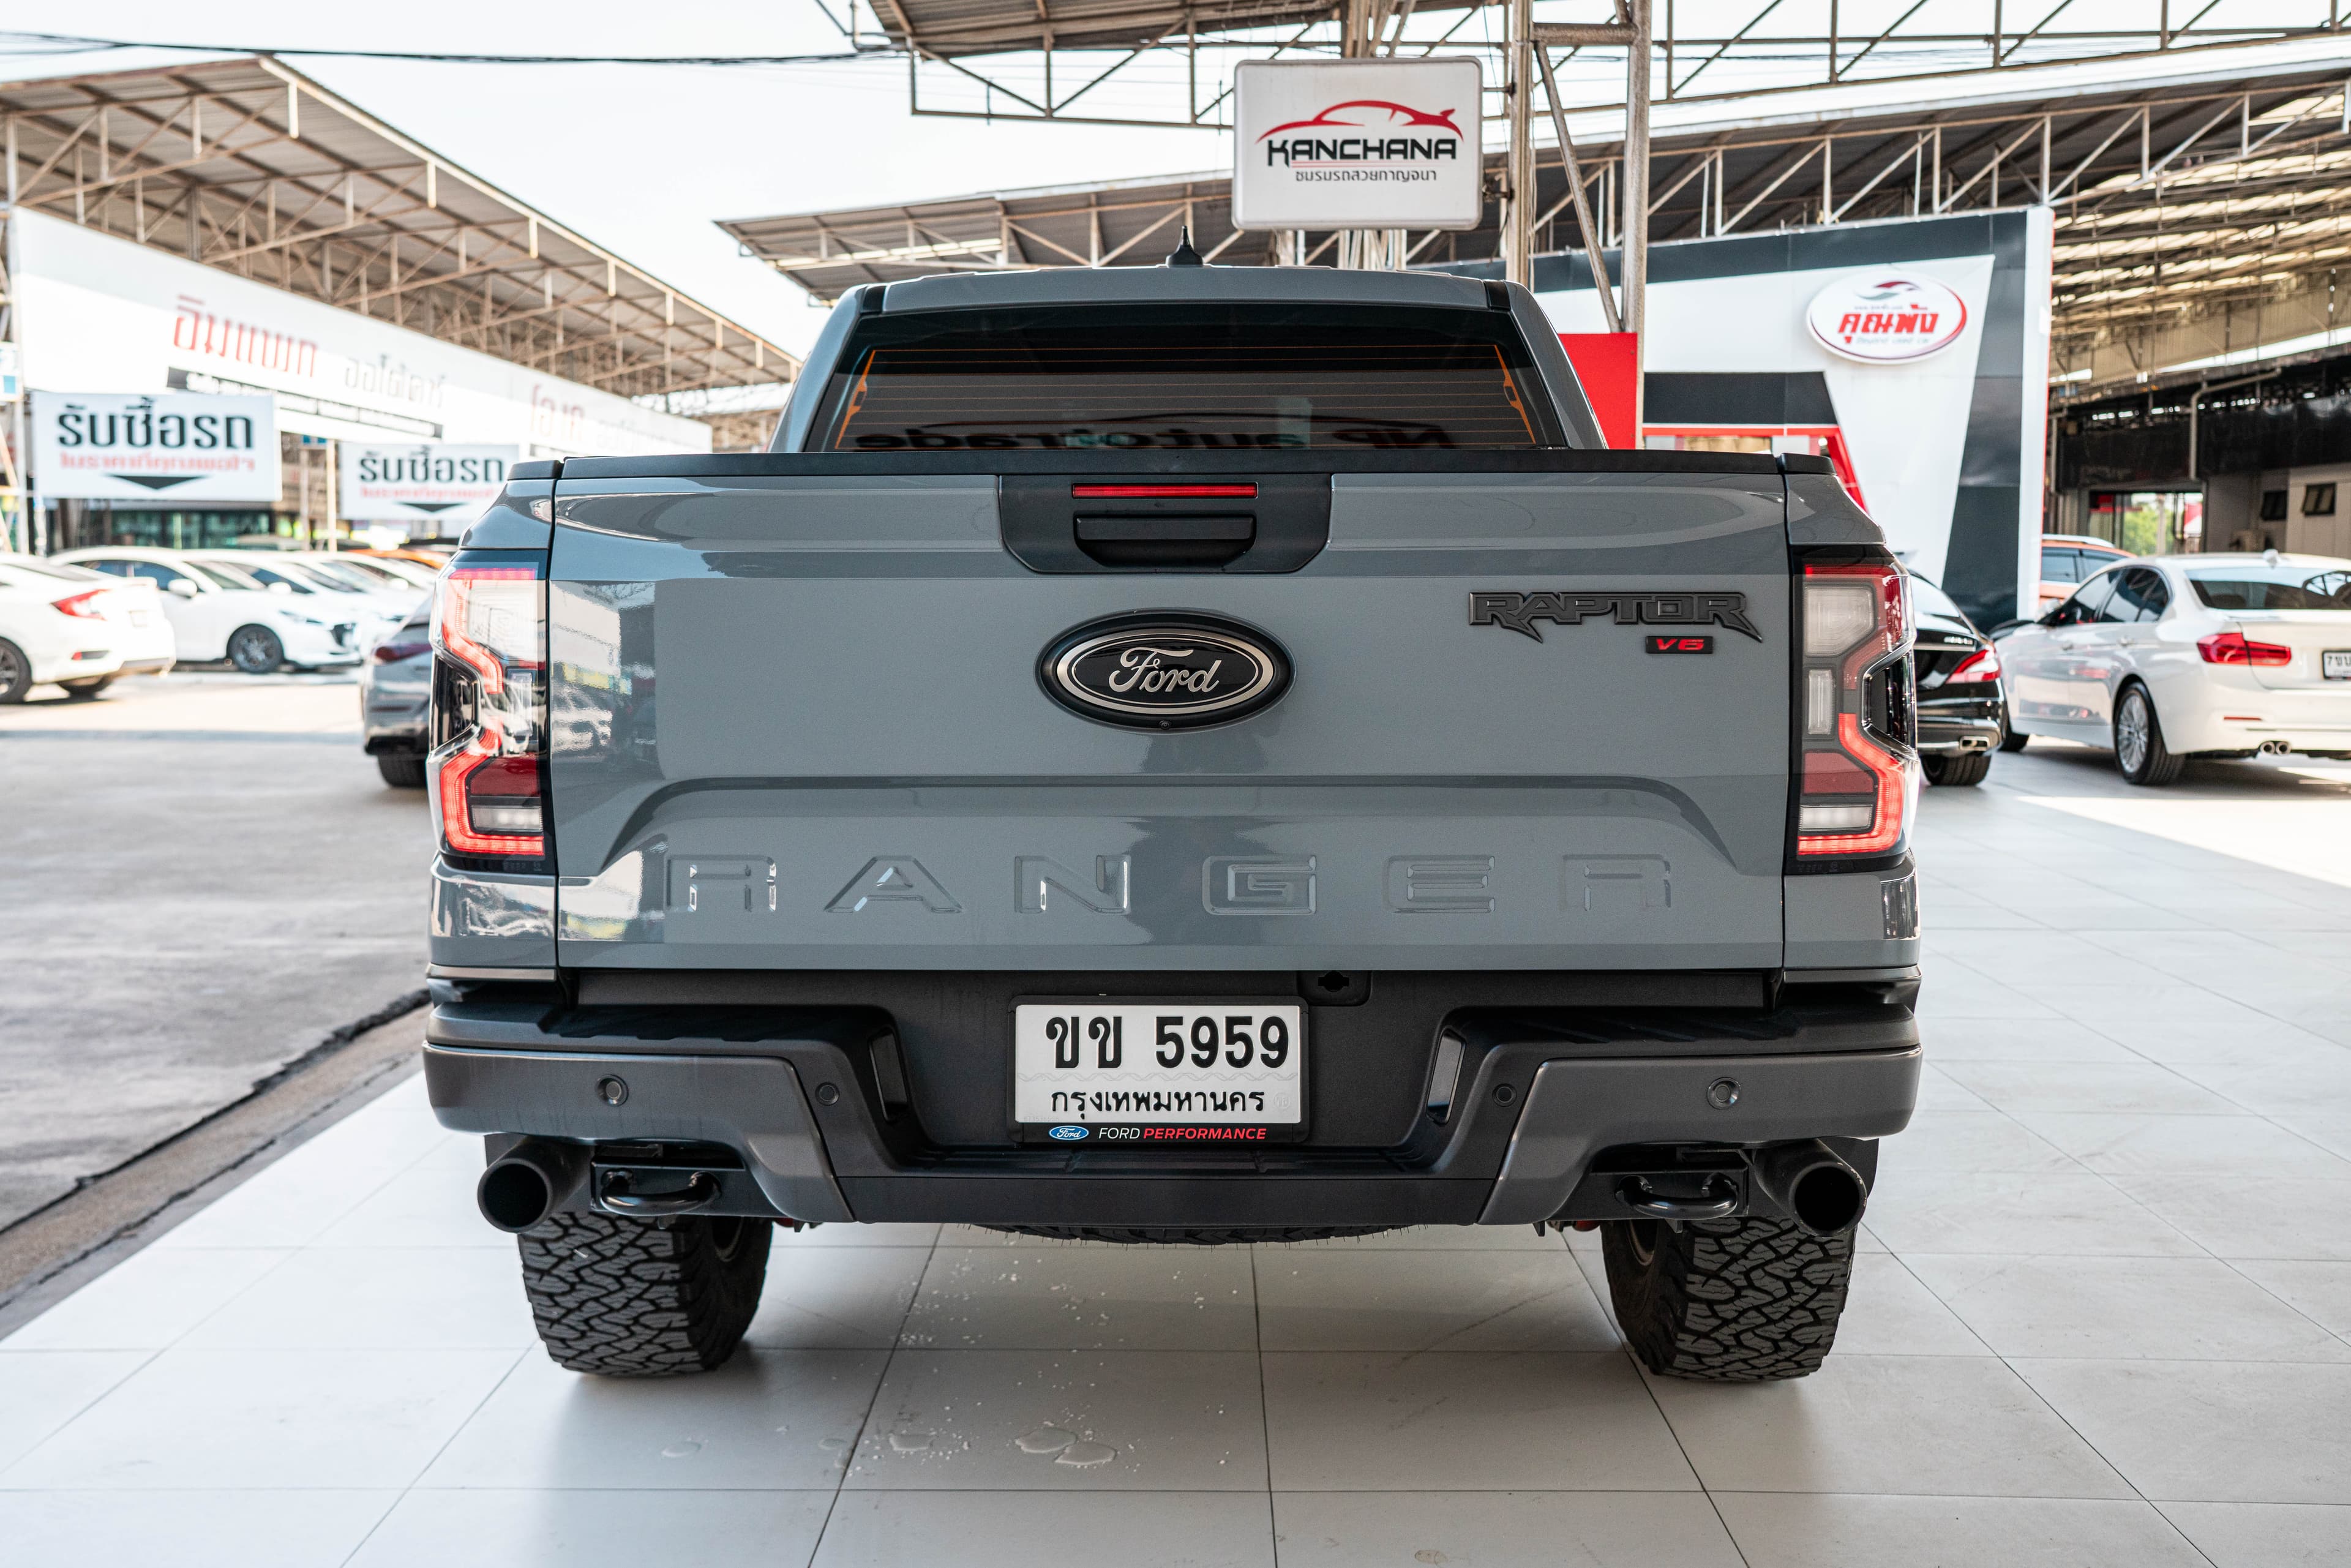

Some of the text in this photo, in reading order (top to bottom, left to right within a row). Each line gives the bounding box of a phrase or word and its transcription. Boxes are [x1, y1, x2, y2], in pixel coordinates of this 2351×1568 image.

[1267, 138, 1457, 168] KANCHANA
[1295, 170, 1437, 183] ชมรมรถสวยกาญจนา
[58, 396, 253, 449] รับซื้อรถ
[1469, 591, 1763, 643] RAPTOR
[1655, 638, 1704, 651] V6
[1108, 646, 1222, 692] Ford
[664, 854, 1672, 915] RANGER
[1045, 1016, 1289, 1068] ขข 5959
[1051, 1090, 1265, 1120] กรุงเทพมหานคร
[1056, 1127, 1267, 1139] Ford FORD PERFORMANCE
